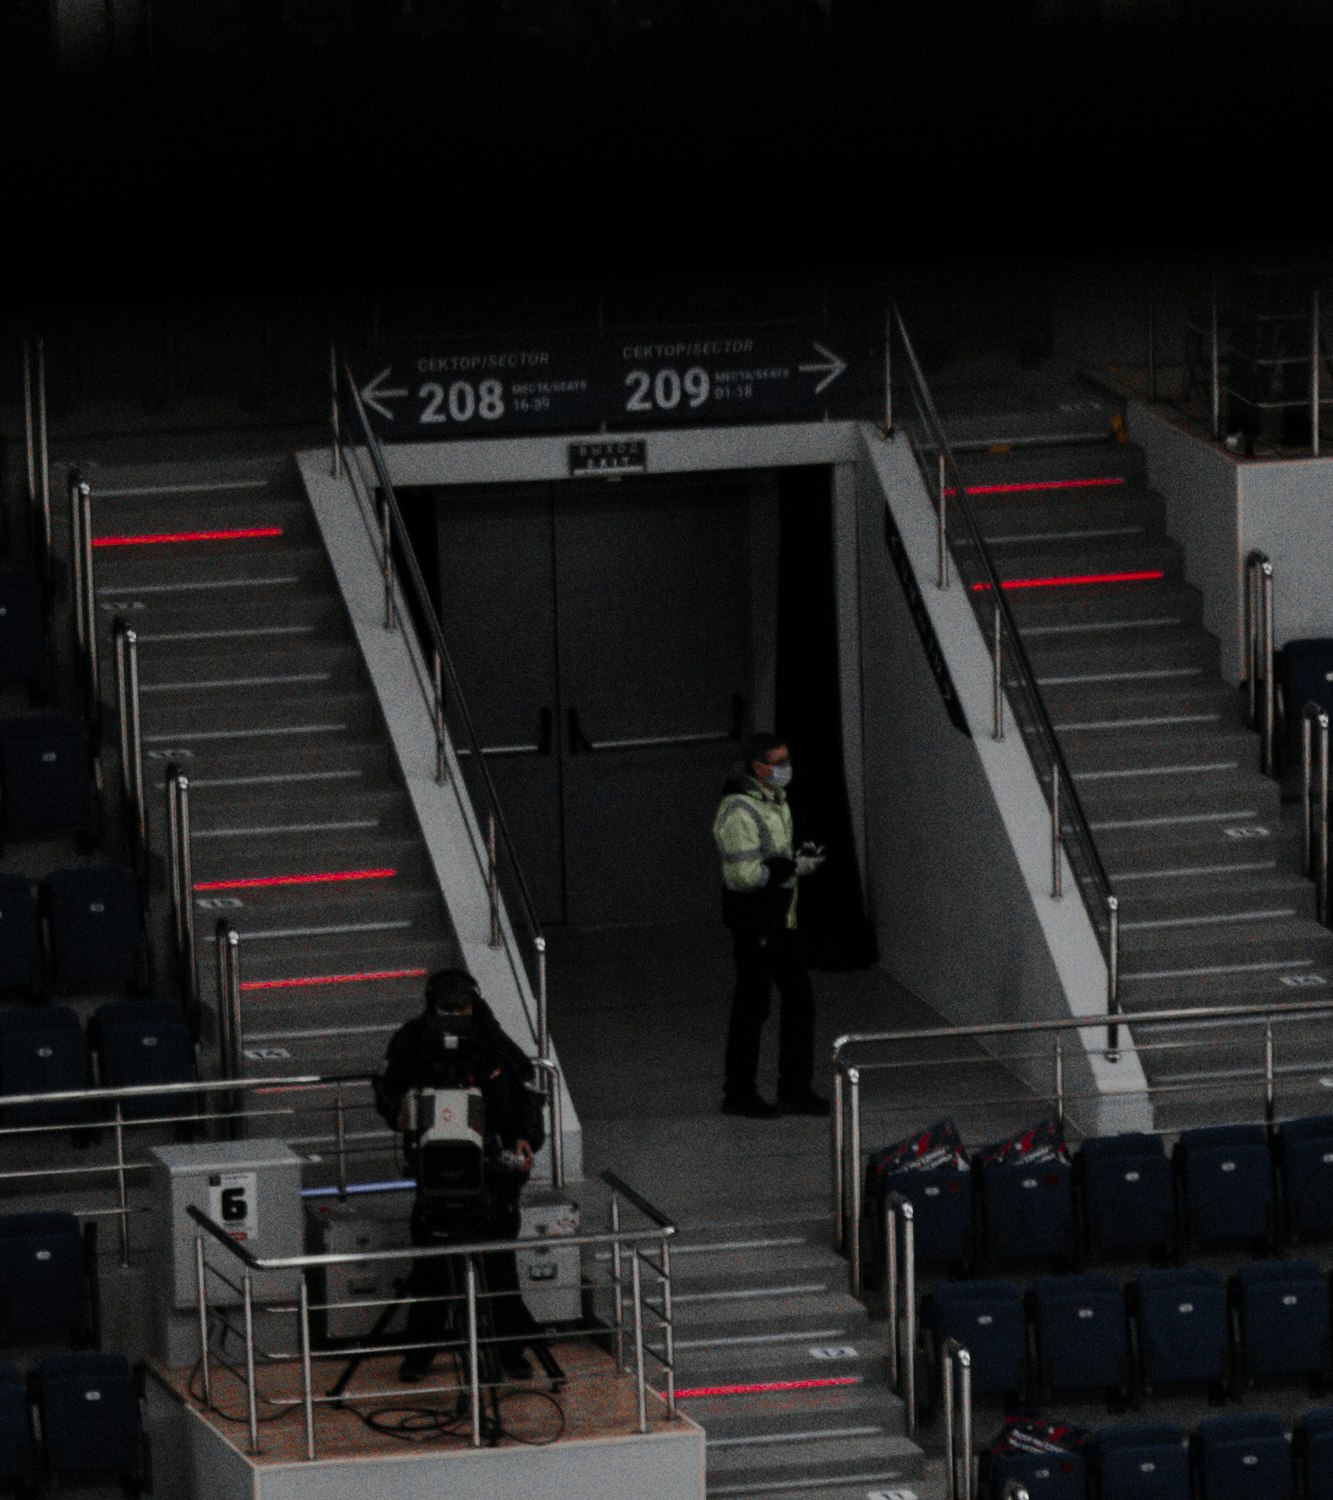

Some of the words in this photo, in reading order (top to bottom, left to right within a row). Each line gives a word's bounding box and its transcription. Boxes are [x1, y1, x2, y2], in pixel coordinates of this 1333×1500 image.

[418, 379, 505, 424] 208
[624, 366, 710, 412] 209
[222, 1188, 247, 1220] 6
